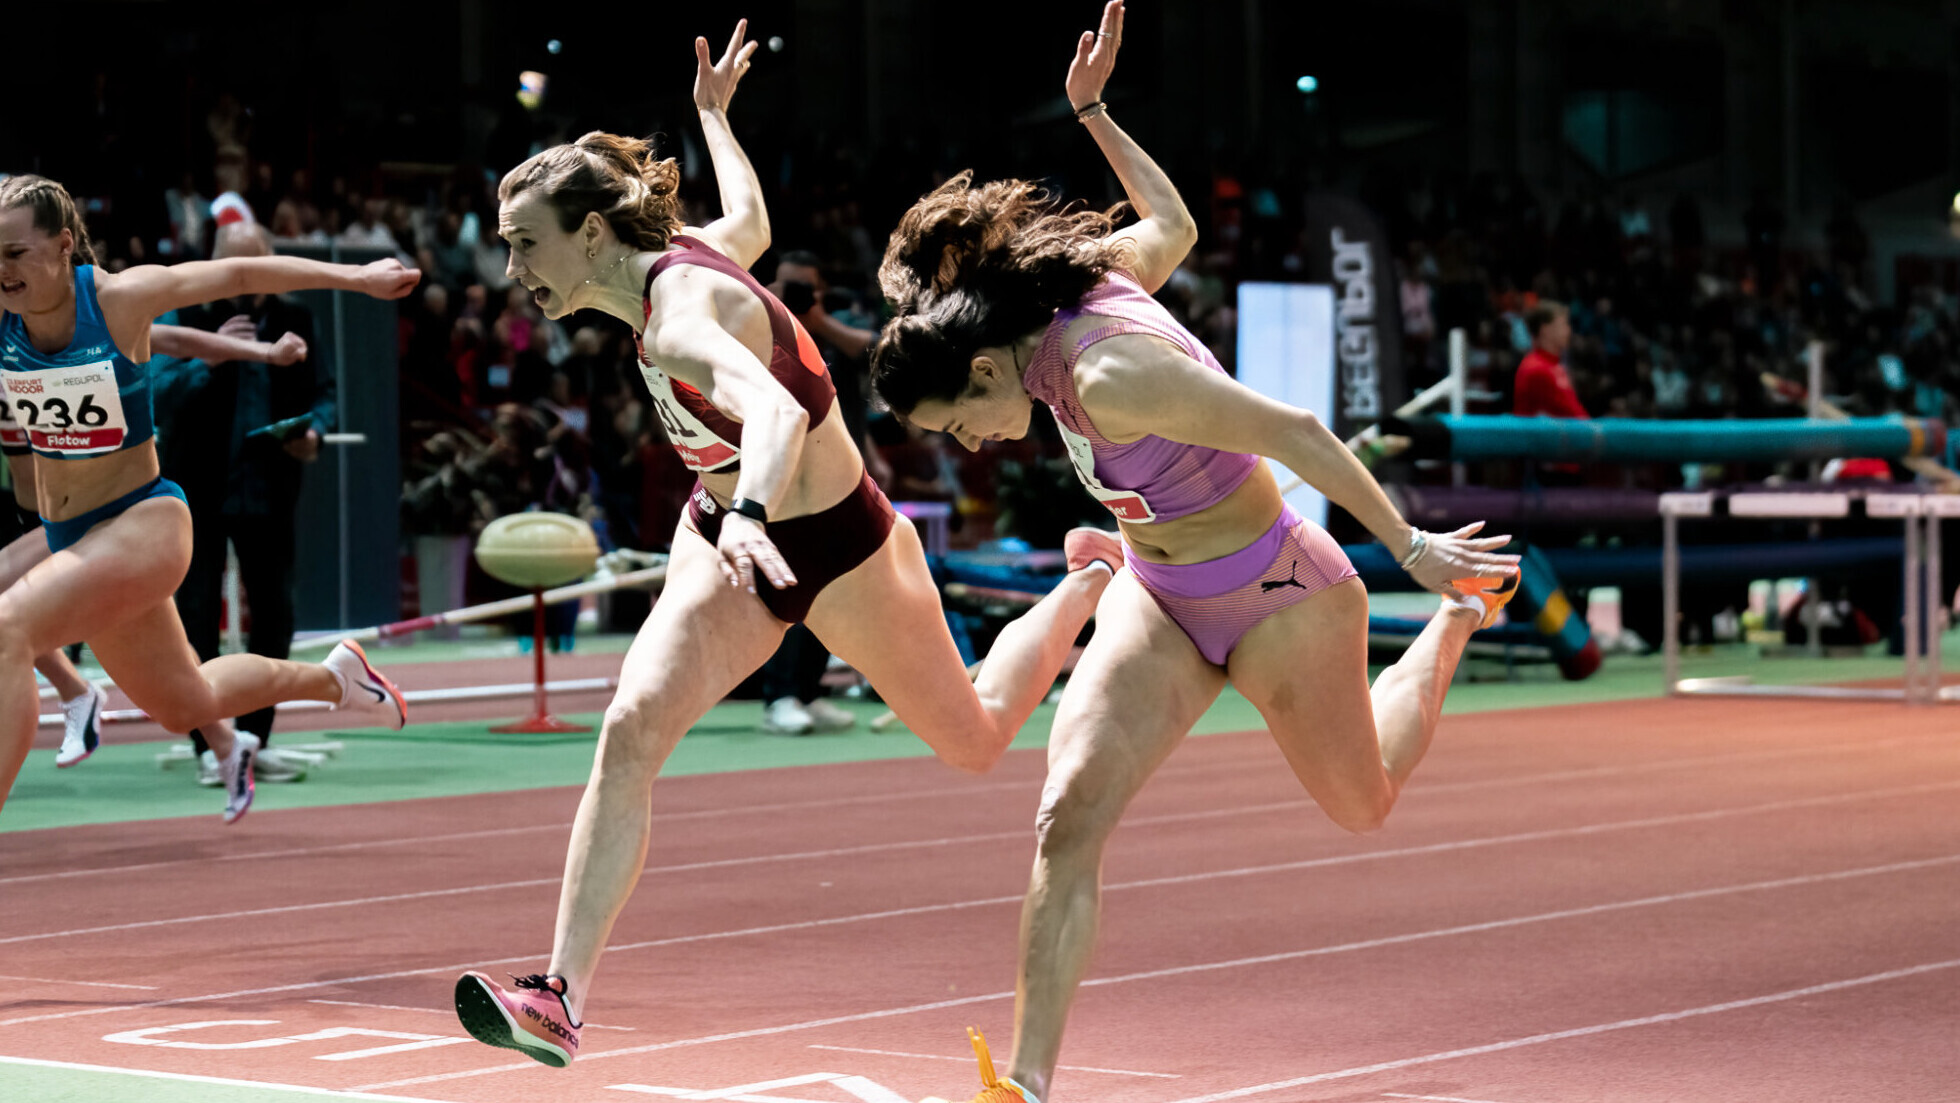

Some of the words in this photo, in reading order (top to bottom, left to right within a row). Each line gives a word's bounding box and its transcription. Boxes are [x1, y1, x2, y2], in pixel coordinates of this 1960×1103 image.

[63, 374, 104, 387] REGUPOL
[8, 384, 44, 394] INDOOR
[17, 395, 108, 428] 236
[47, 435, 91, 447] Flotow
[522, 1003, 542, 1022] new
